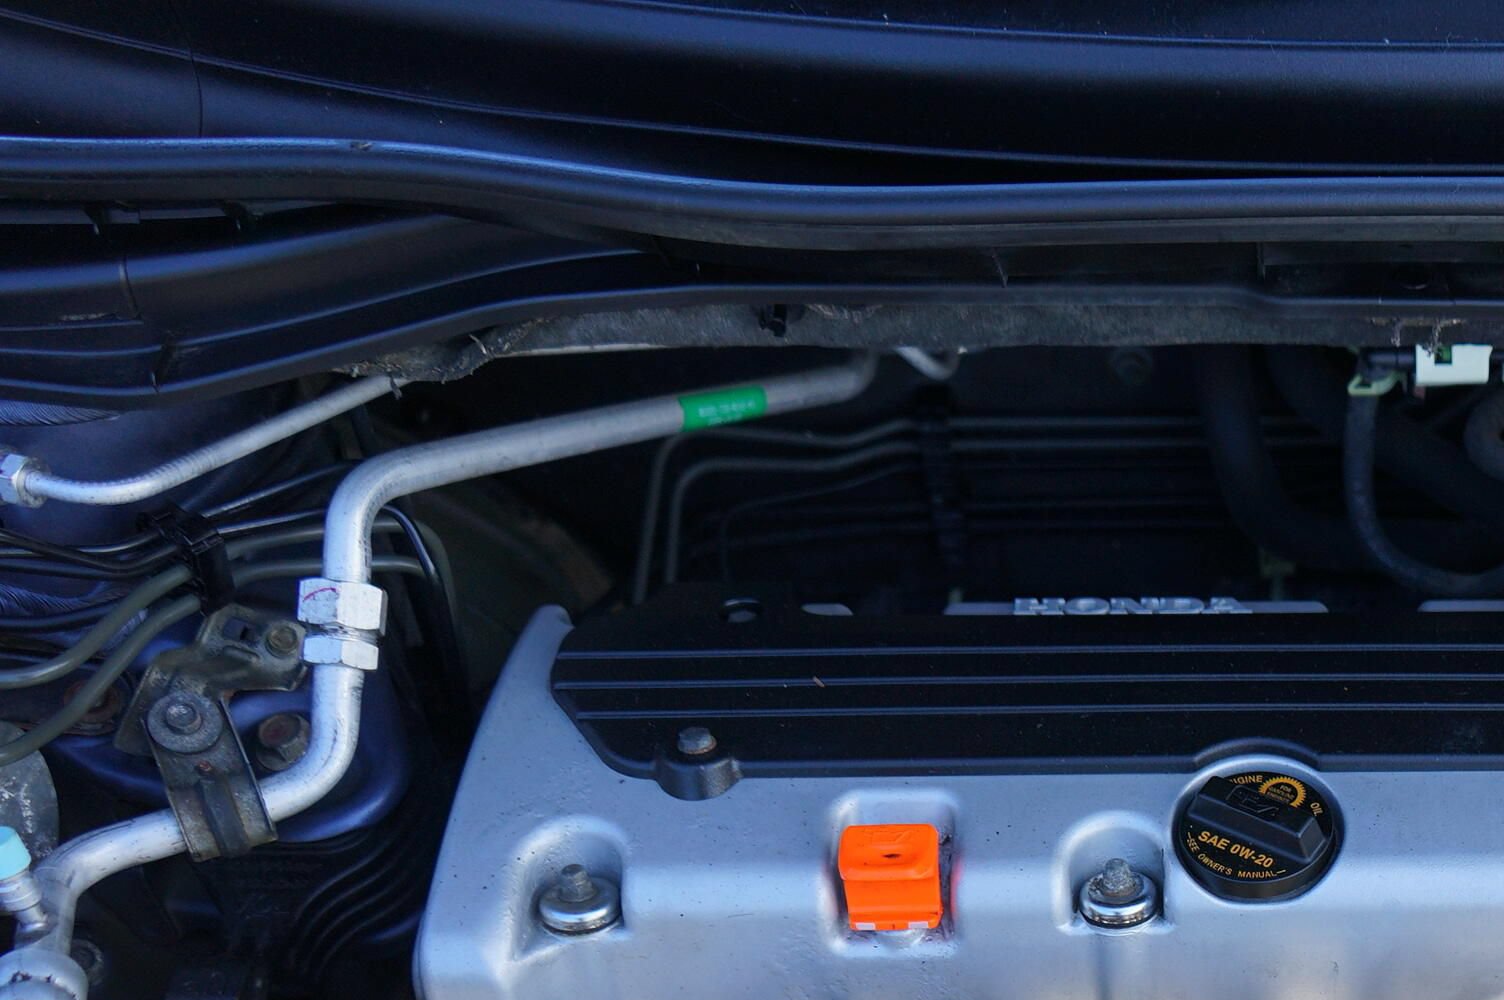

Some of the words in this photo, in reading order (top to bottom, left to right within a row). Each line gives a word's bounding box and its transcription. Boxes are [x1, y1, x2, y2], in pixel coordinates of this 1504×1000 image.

[1013, 597, 1253, 615] HONDA
[1310, 802, 1324, 817] OIL
[1198, 831, 1231, 854] SAE
[1229, 843, 1275, 869] 0W-20
[1197, 853, 1233, 876] OWNER'S
